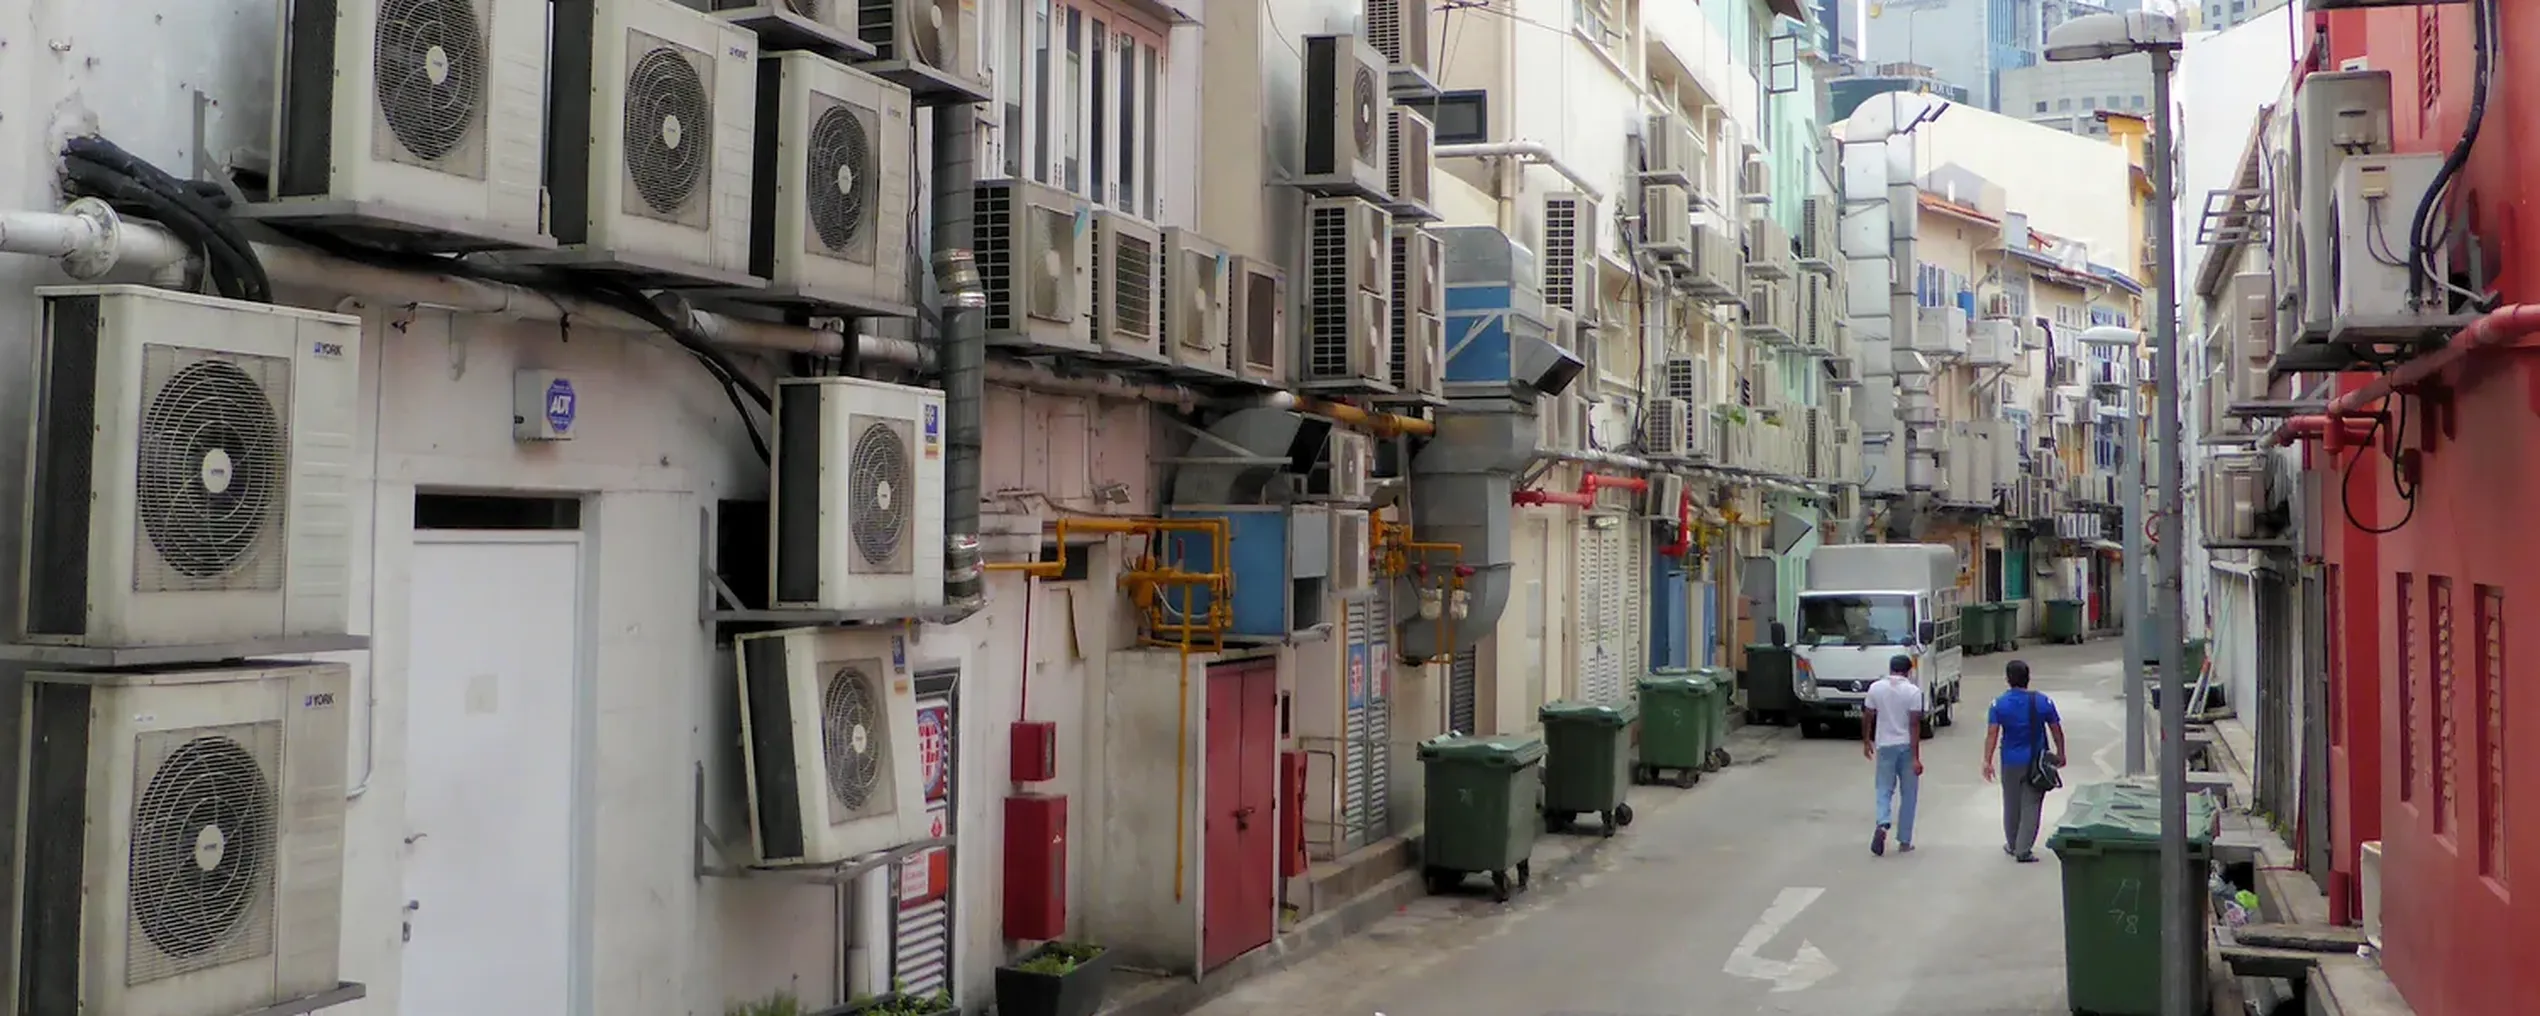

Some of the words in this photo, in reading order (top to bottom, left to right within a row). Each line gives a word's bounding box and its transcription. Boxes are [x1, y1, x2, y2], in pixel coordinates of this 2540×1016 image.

[321, 343, 344, 356] YORK
[550, 395, 571, 414] ADT
[312, 692, 335, 706] YORK
[2108, 908, 2139, 934] 78
